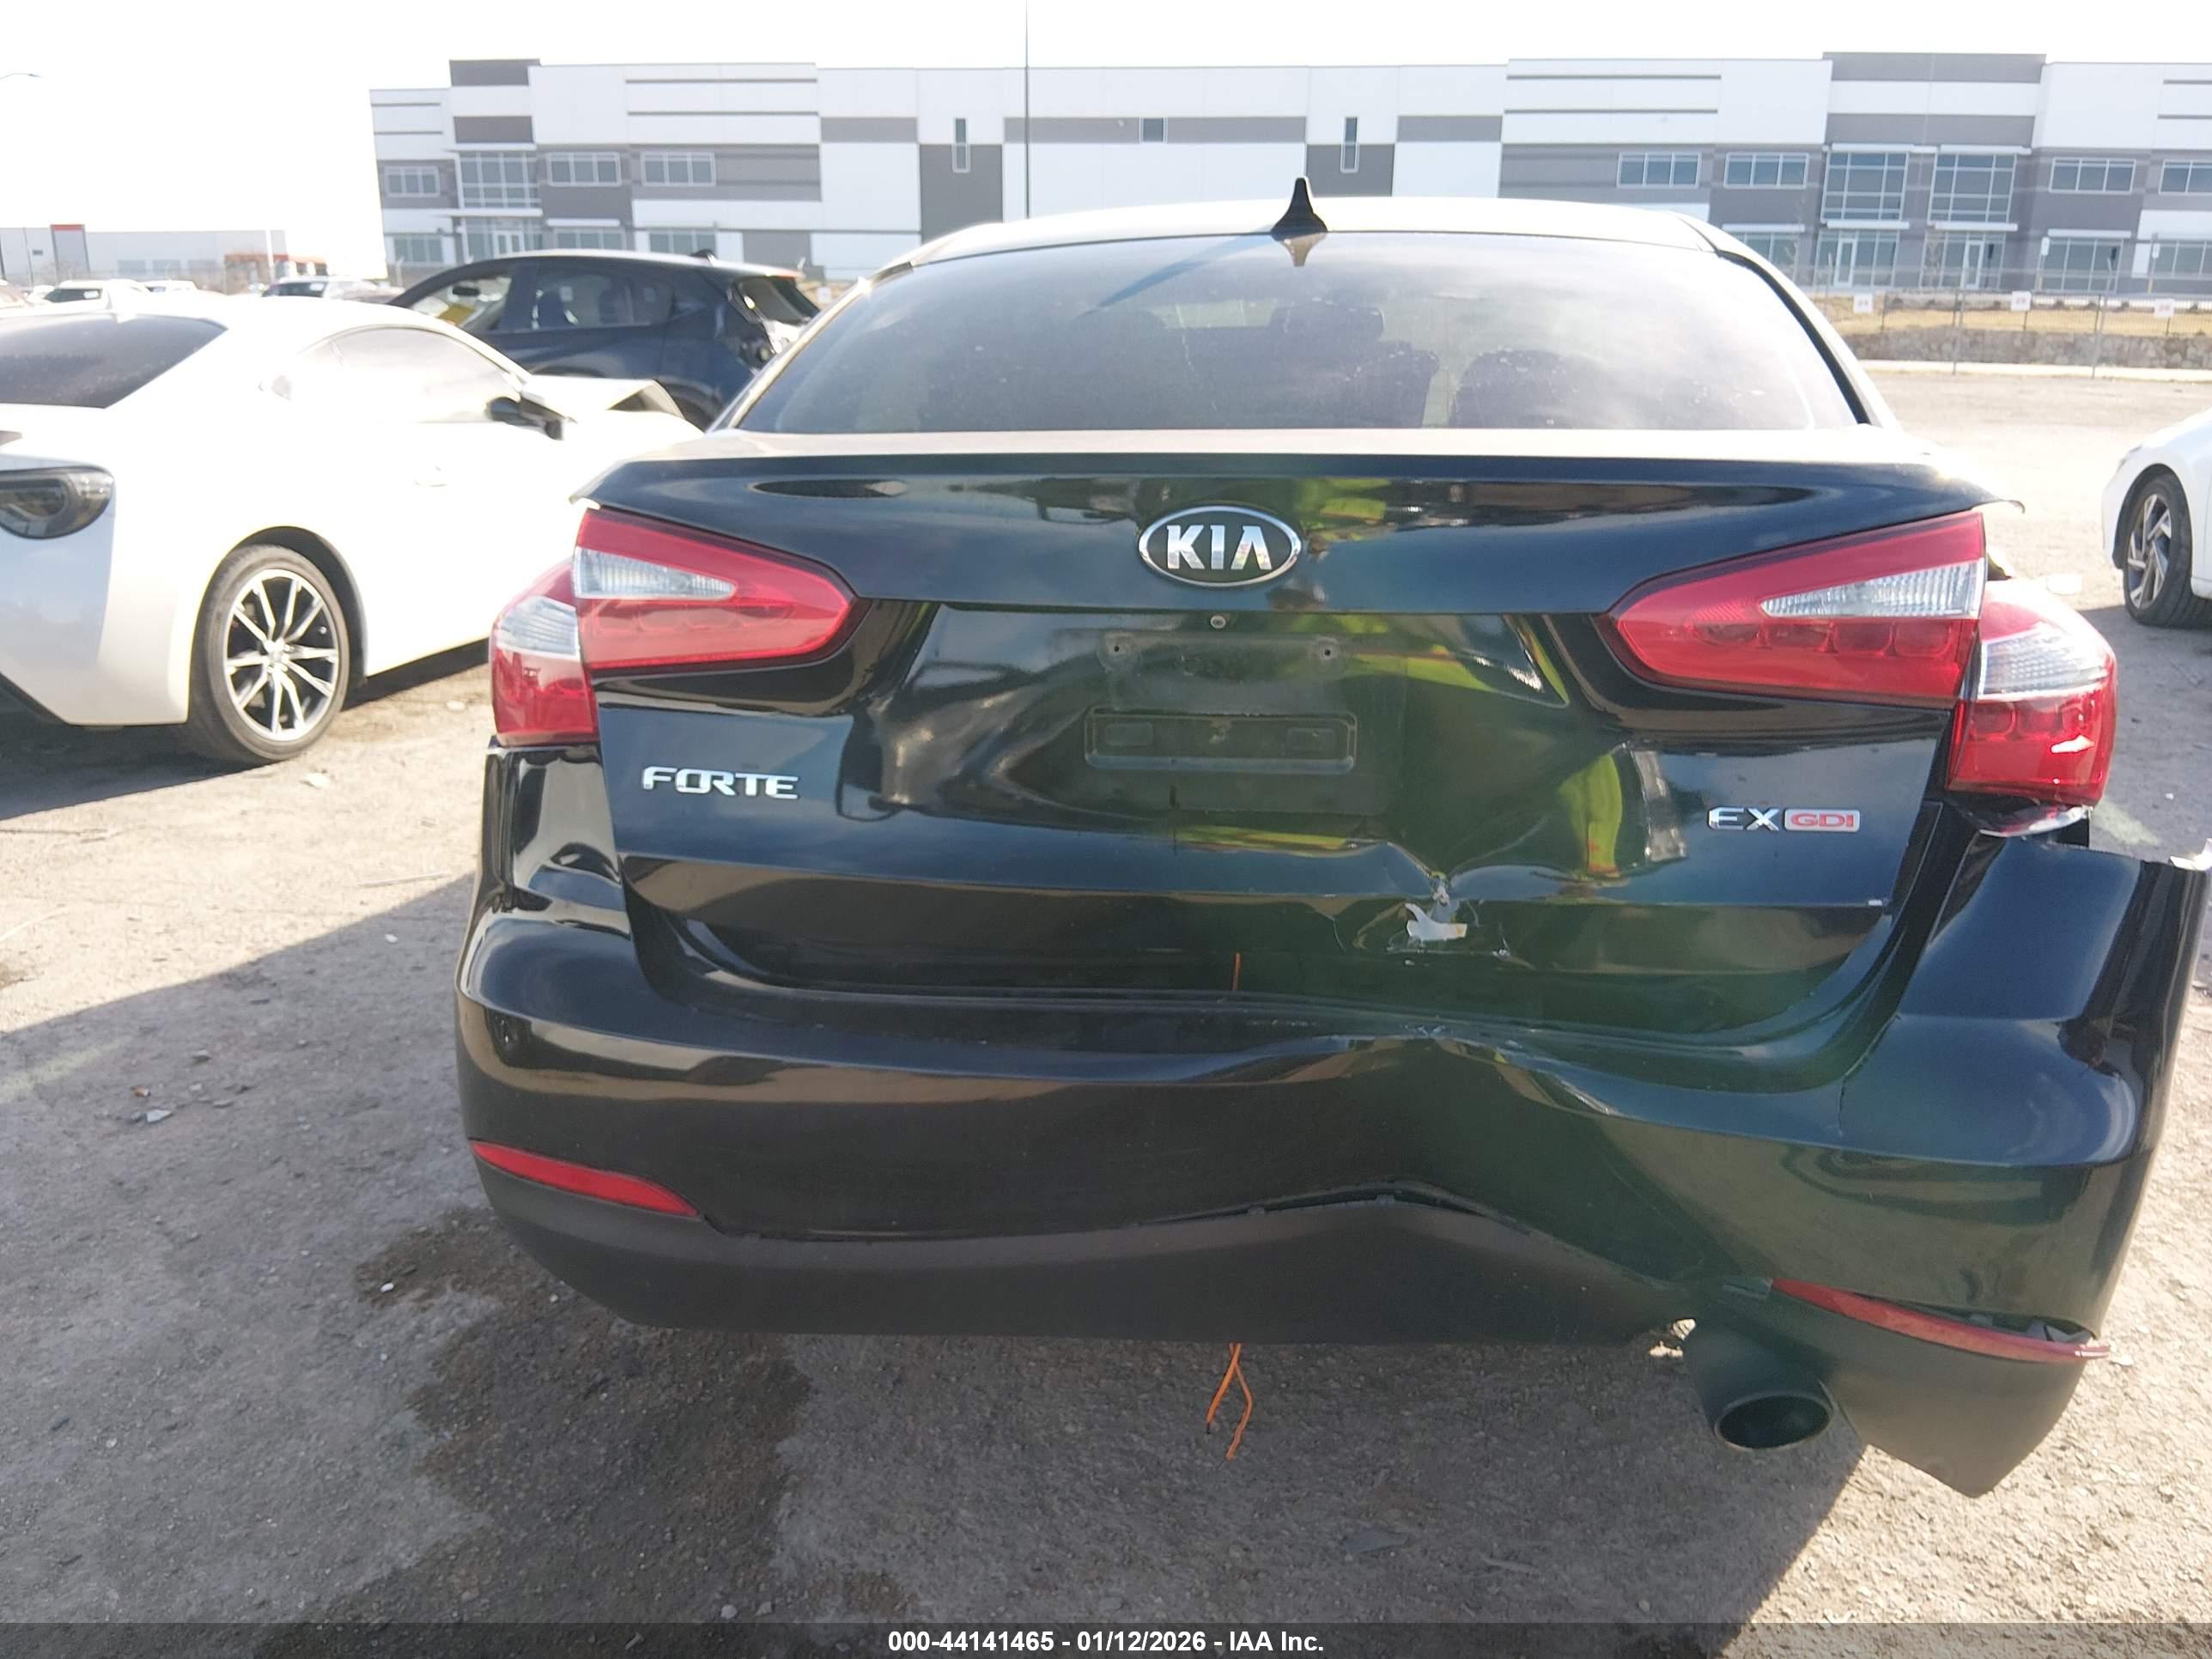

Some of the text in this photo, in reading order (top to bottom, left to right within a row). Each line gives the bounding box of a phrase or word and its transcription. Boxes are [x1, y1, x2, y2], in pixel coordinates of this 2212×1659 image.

[1166, 524, 1273, 570] KIA
[642, 766, 799, 799] FORTE
[1708, 806, 1854, 831] EX GDI
